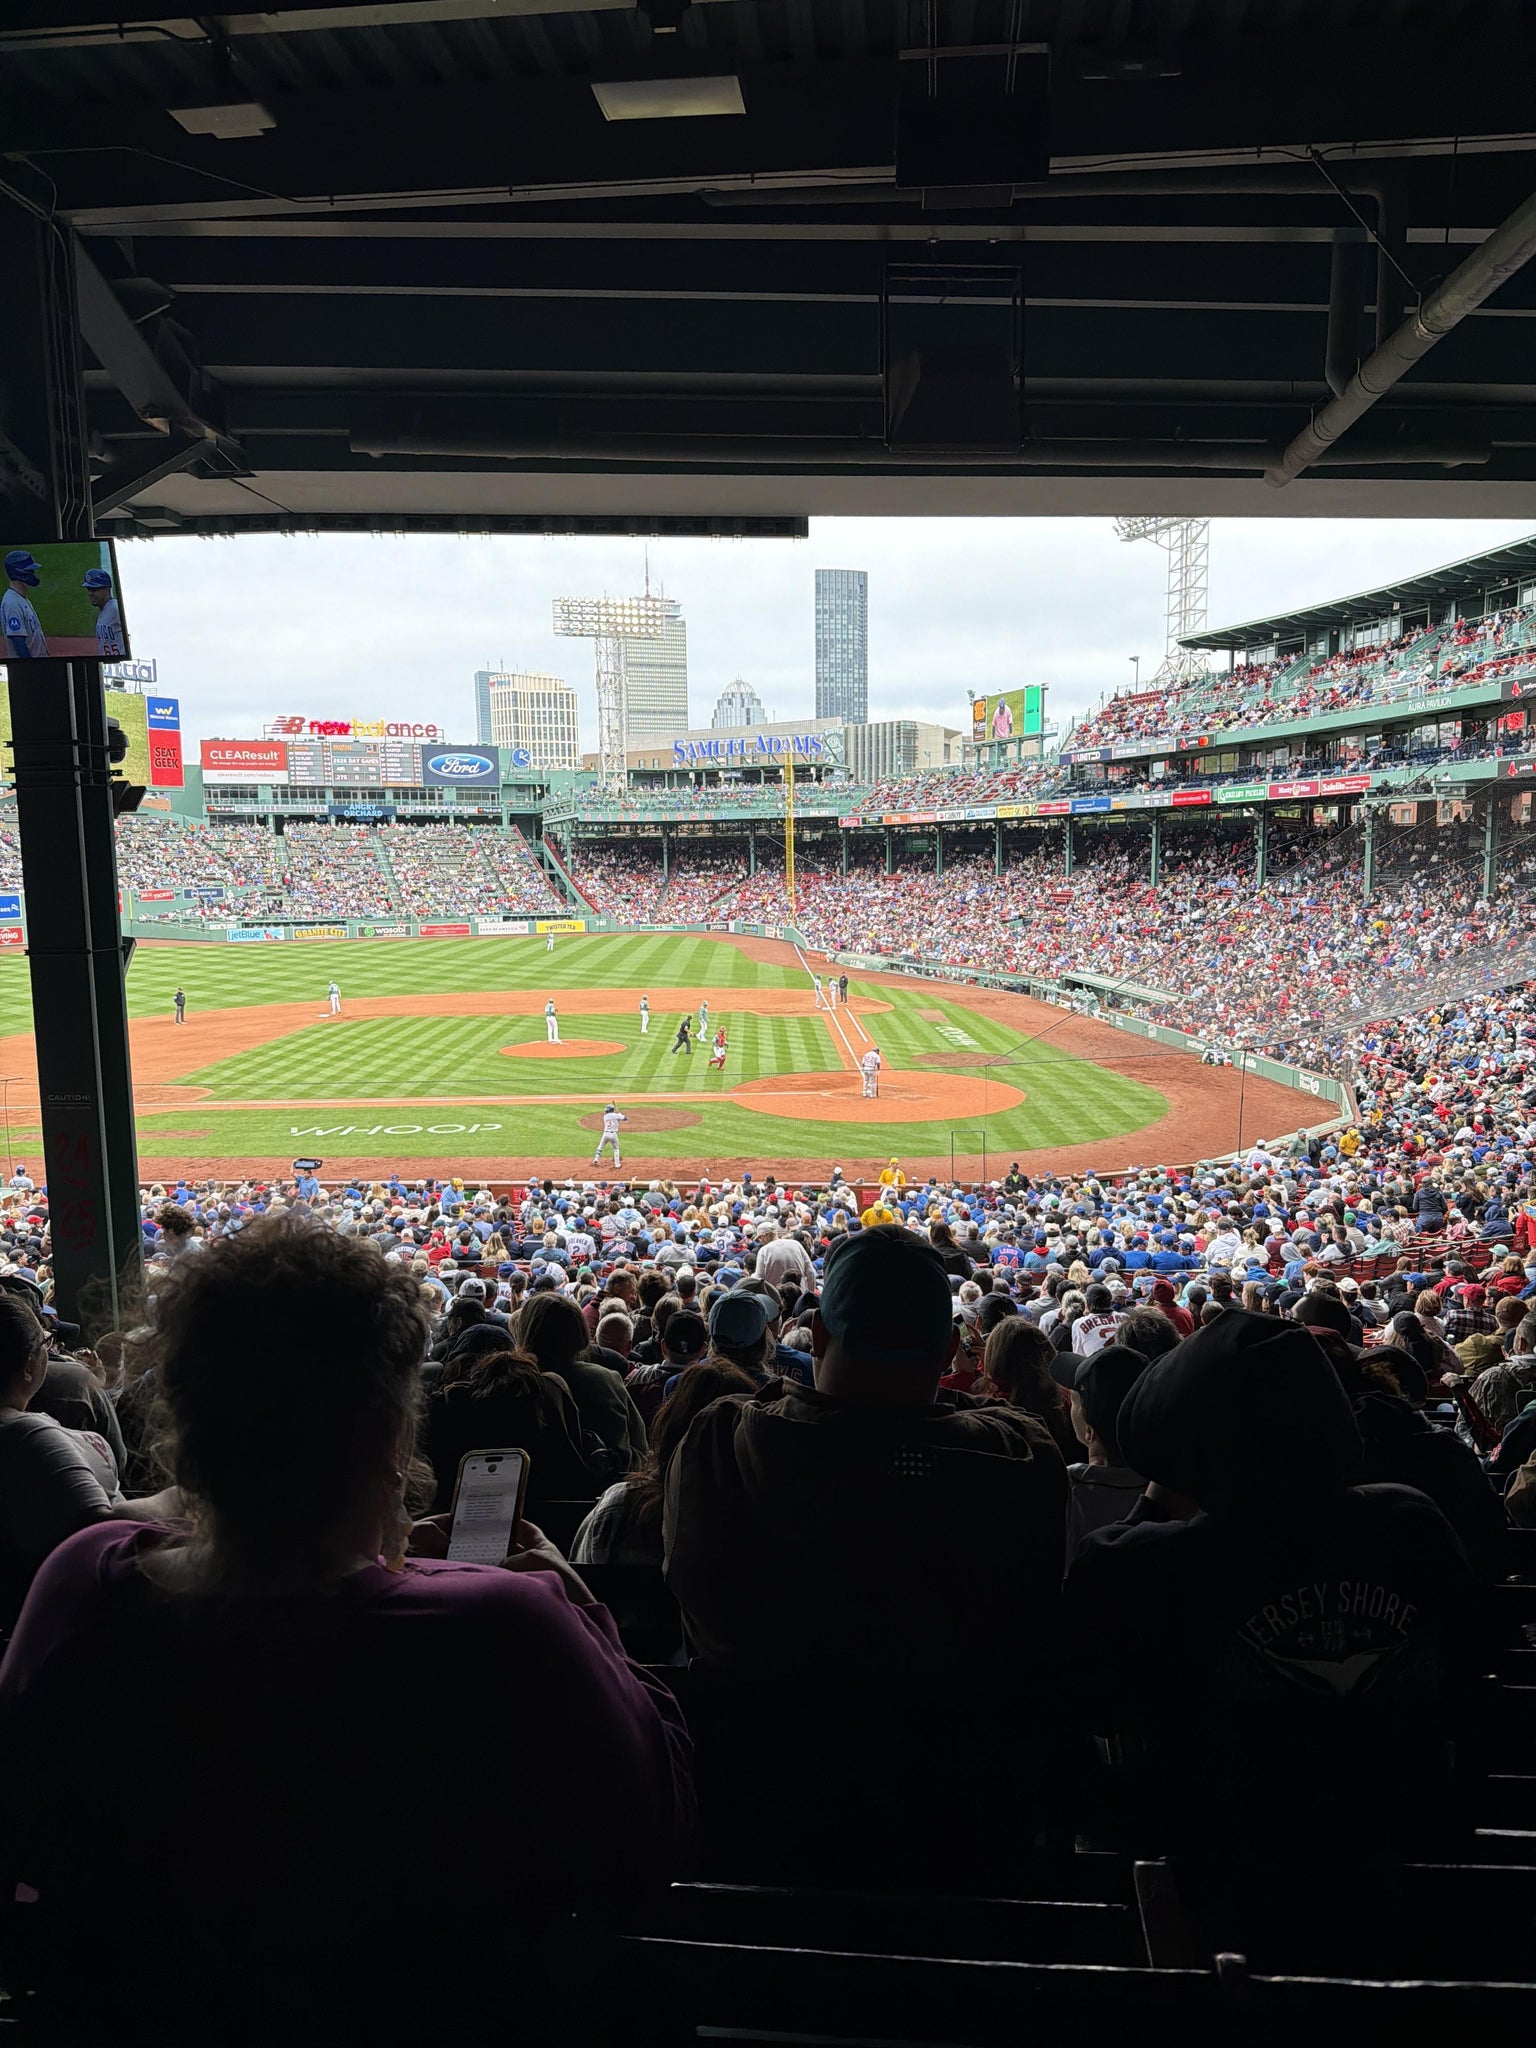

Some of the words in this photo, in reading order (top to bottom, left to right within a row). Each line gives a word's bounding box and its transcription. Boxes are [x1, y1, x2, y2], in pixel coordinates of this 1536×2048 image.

[309, 720, 350, 736] new
[352, 716, 437, 738] balance
[155, 747, 177, 758] SEAT
[673, 738, 751, 764] SAMUEL
[753, 733, 824, 755] ADAMS
[209, 750, 280, 761] CLEAResult
[155, 758, 179, 769] GEEK
[441, 757, 480, 774] Ford
[1322, 781, 1346, 792] Safelite
[153, 891, 173, 899] TICKET
[230, 929, 261, 940] jetBlue
[295, 928, 329, 938] GRANITE
[329, 927, 347, 938] CITY
[375, 925, 406, 933] wasabi
[47, 1093, 91, 1101] CAUTION!
[290, 1123, 503, 1136] WHOOP
[55, 1131, 89, 1172] 24
[58, 1199, 96, 1239] 25
[1079, 1313, 1123, 1335] BREGMA
[1237, 1582, 1328, 1652] JERSEY
[1337, 1580, 1418, 1637] SHORE
